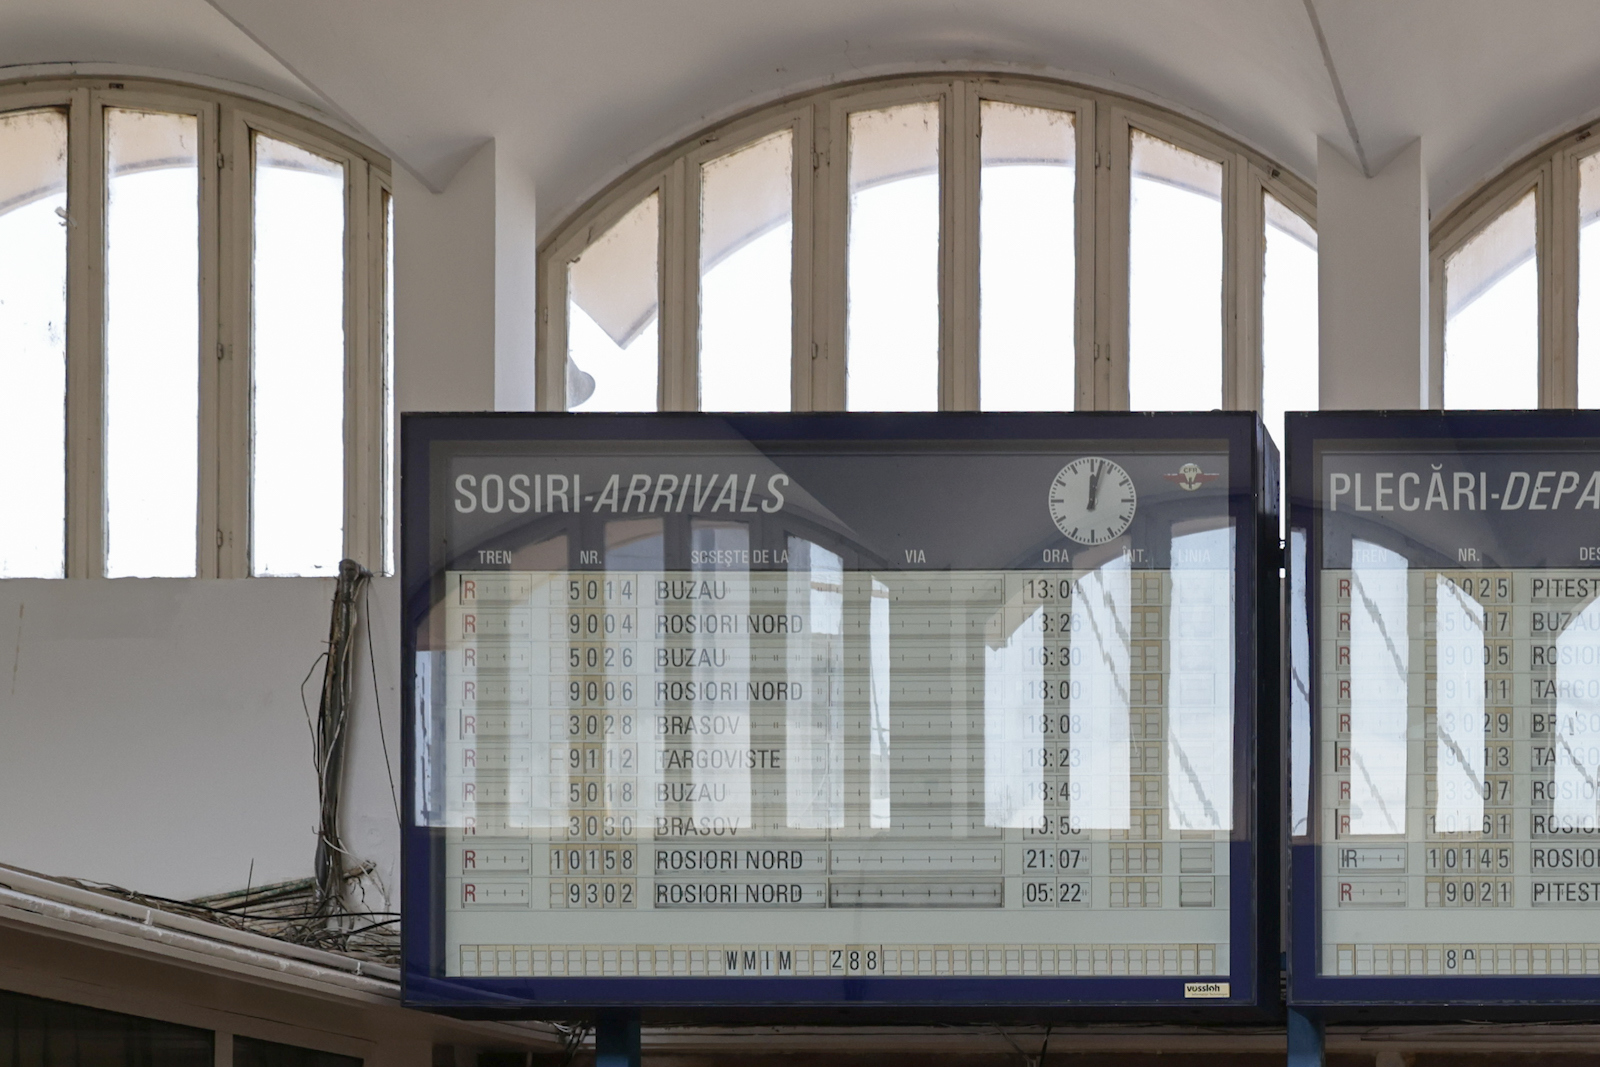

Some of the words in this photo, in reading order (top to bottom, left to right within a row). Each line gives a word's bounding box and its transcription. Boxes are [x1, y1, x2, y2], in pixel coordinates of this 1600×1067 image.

[454, 473, 789, 514] SOSIRI-ARRIVALS
[478, 550, 512, 564] TREN
[580, 550, 602, 564] NR.
[753, 549, 769, 563] DE
[773, 549, 790, 563] LA
[905, 549, 926, 564] VIA
[1043, 548, 1069, 563] ORA
[1178, 548, 1211, 563] LINIA
[1354, 549, 1387, 563] TREN
[1458, 547, 1480, 562] NR.
[464, 580, 476, 600] R
[569, 580, 632, 600] 5014
[656, 580, 726, 600] BUZAU
[1339, 579, 1351, 598] R
[464, 614, 476, 633] R
[569, 614, 632, 633] 9004
[656, 614, 738, 633] ROSIORI
[748, 614, 802, 633] NORD
[1339, 612, 1351, 631] R
[464, 647, 476, 667] R
[569, 647, 632, 667] 5026
[656, 647, 726, 667] BUZAU
[1339, 646, 1351, 665] R
[464, 681, 476, 701] R
[569, 681, 632, 701] 9006
[656, 681, 738, 701] ROSIORI
[748, 681, 802, 701] NORD
[1339, 680, 1351, 699] R
[464, 715, 476, 734] R
[569, 715, 632, 734] 3028
[656, 715, 740, 734] BRASOV
[1339, 714, 1351, 733] R
[464, 749, 476, 768] R
[569, 749, 632, 768] 9112
[658, 749, 781, 768] TARGOVISTE
[1340, 747, 1351, 766] R
[464, 782, 476, 802] R
[569, 782, 632, 802] 5018
[656, 782, 726, 802] BUZAU
[1340, 781, 1351, 800] R
[464, 816, 476, 836] R
[569, 816, 632, 836] 3030
[656, 816, 740, 836] BRASOV
[1340, 815, 1351, 834] R
[464, 850, 476, 869] R
[553, 850, 632, 869] 10158
[656, 850, 738, 869] ROSIORI
[746, 850, 802, 869] NORD
[1026, 849, 1082, 869] 21:07
[1430, 849, 1509, 868] 10145
[464, 884, 476, 903] R
[569, 884, 632, 903] 9302
[656, 884, 738, 903] ROSIORI
[746, 884, 802, 903] NORD
[1026, 883, 1082, 902] 05:22
[1340, 882, 1352, 901] R
[1446, 882, 1509, 901] 9021
